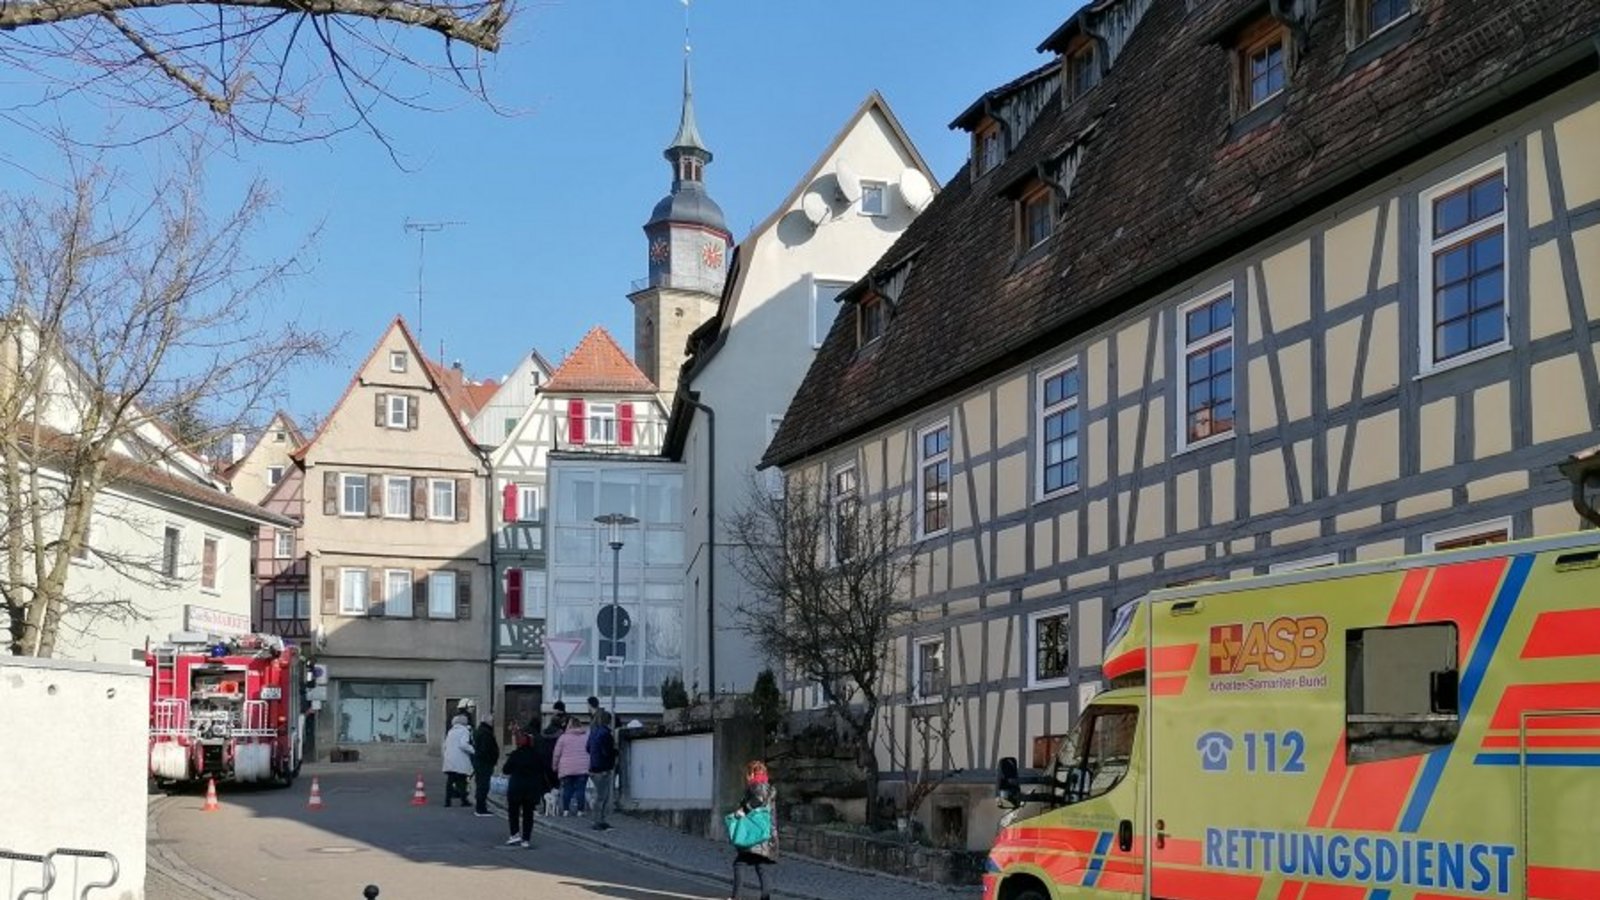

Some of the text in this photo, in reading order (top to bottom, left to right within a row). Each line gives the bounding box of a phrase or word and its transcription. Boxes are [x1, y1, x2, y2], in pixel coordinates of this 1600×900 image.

[1233, 616, 1328, 673] ASB
[1209, 675, 1328, 692] Arbeiter-Samariter-Bund
[1243, 730, 1305, 772] 112
[1206, 827, 1515, 894] RETTUNGSDIENST
